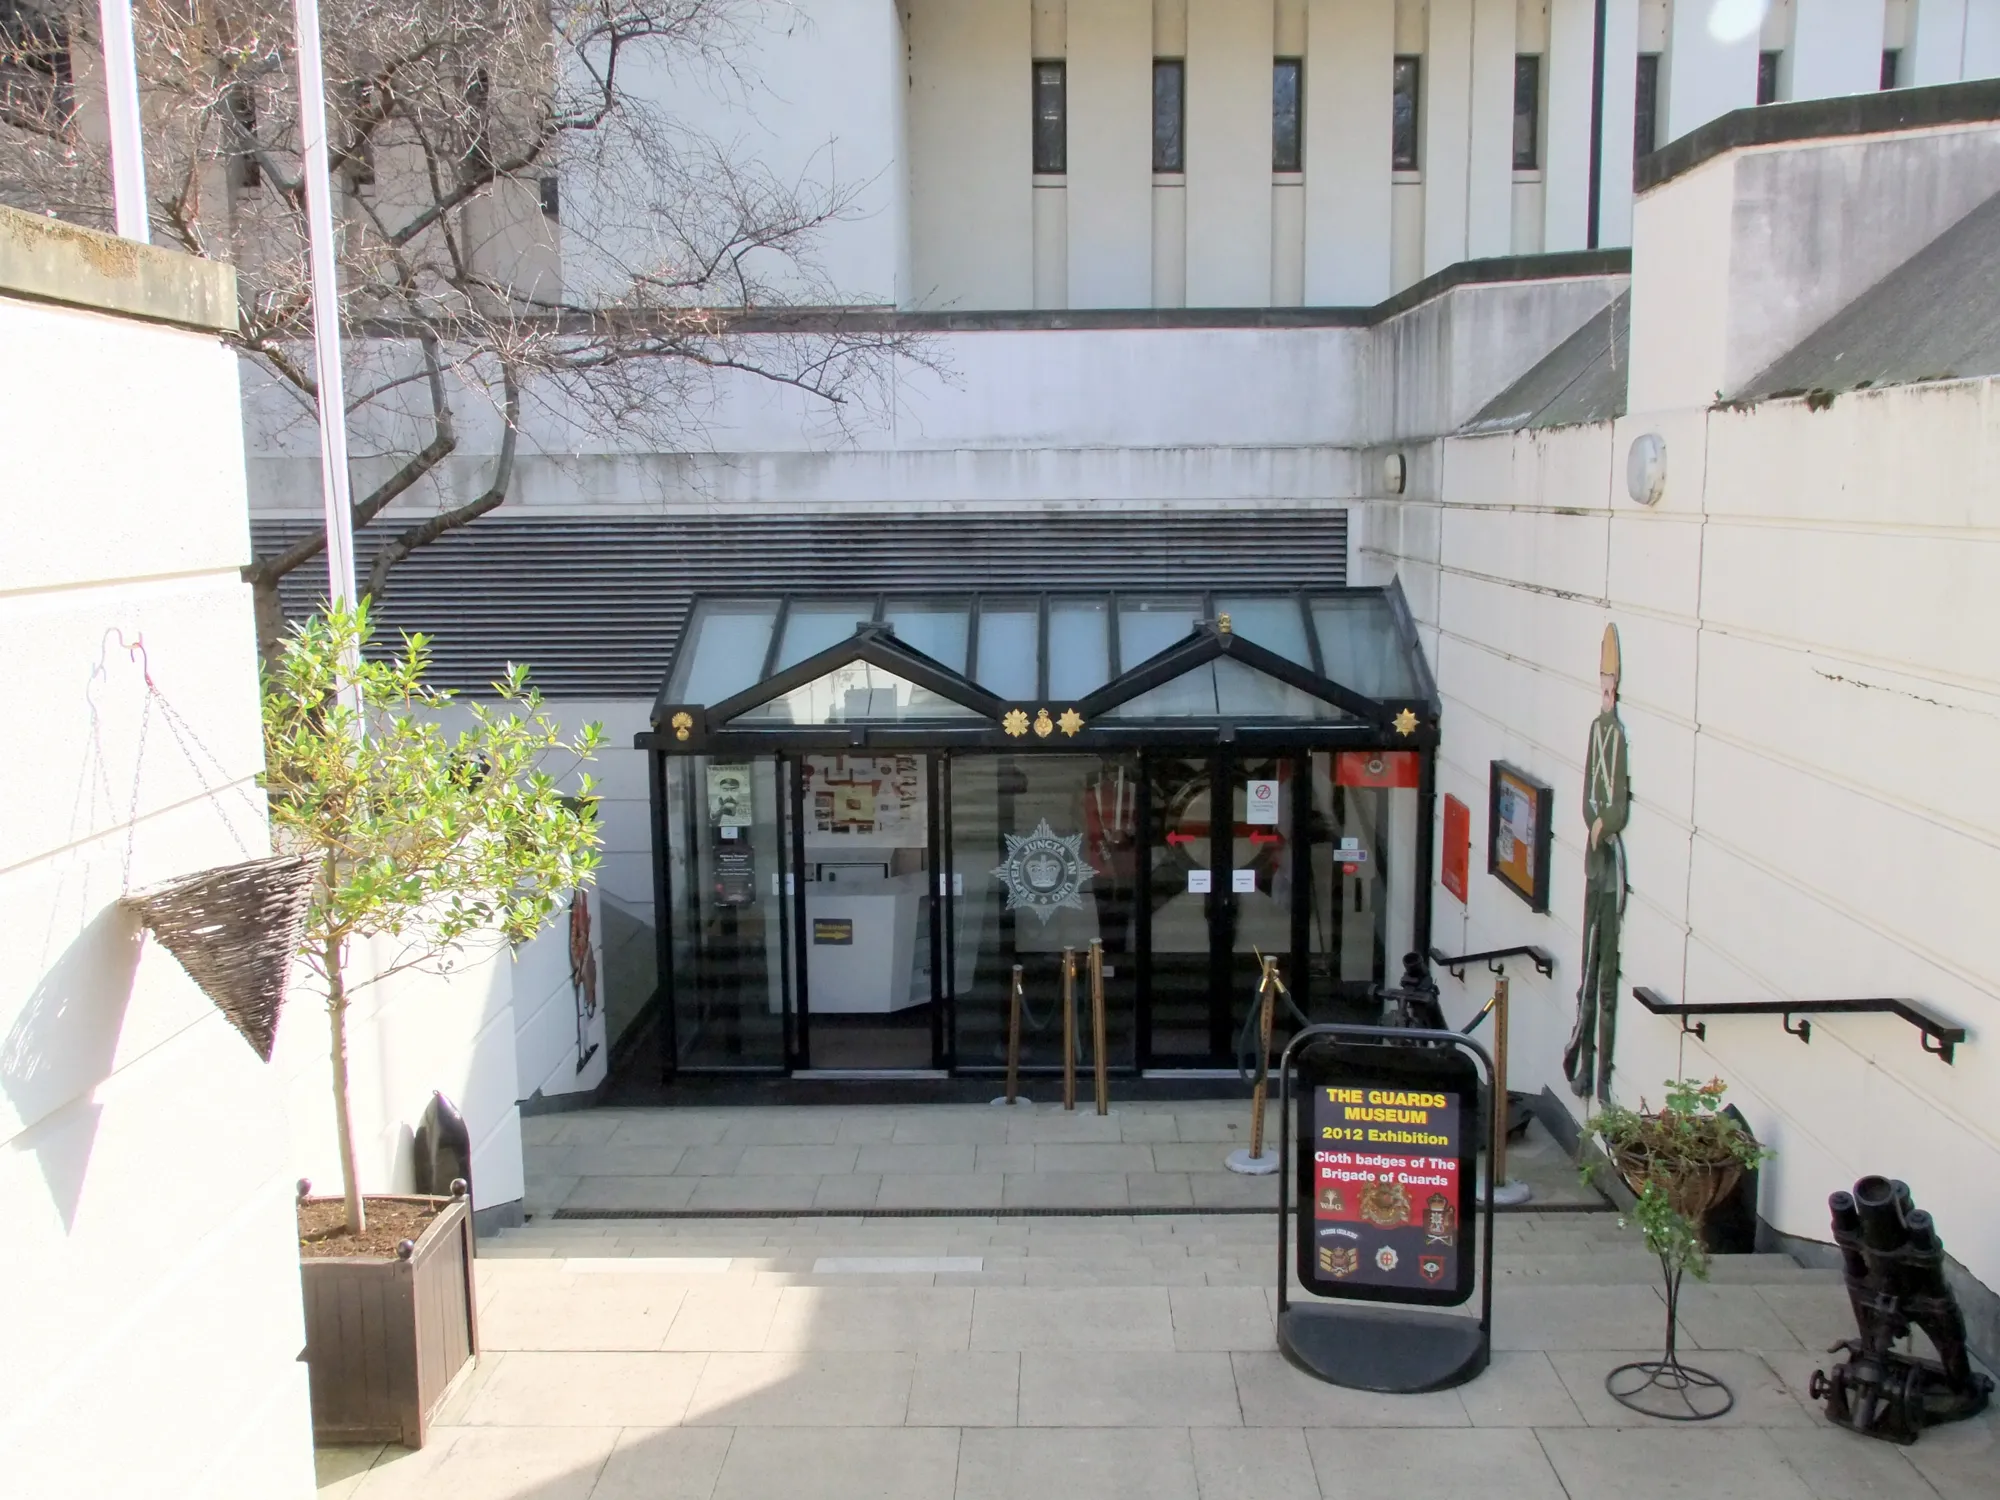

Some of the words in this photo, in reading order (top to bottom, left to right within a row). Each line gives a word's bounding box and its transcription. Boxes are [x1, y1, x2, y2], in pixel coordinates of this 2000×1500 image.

[1023, 839, 1066, 857] JUNCTA
[1067, 861, 1076, 875] IN
[1011, 860, 1036, 902] SEPTEM
[1051, 882, 1073, 902] UNO
[1326, 1088, 1363, 1104] THE
[1368, 1090, 1447, 1108] GUARDS
[1344, 1107, 1428, 1125] MUSEUM
[1322, 1127, 1364, 1141] 2012
[1368, 1129, 1448, 1145] Exhibition
[1314, 1152, 1352, 1164] Cloth
[1355, 1154, 1406, 1168] badges
[1410, 1157, 1425, 1168] of
[1428, 1158, 1456, 1170] The
[1321, 1168, 1376, 1183] Brigade
[1379, 1171, 1393, 1182] of
[1397, 1173, 1448, 1186] Guards
